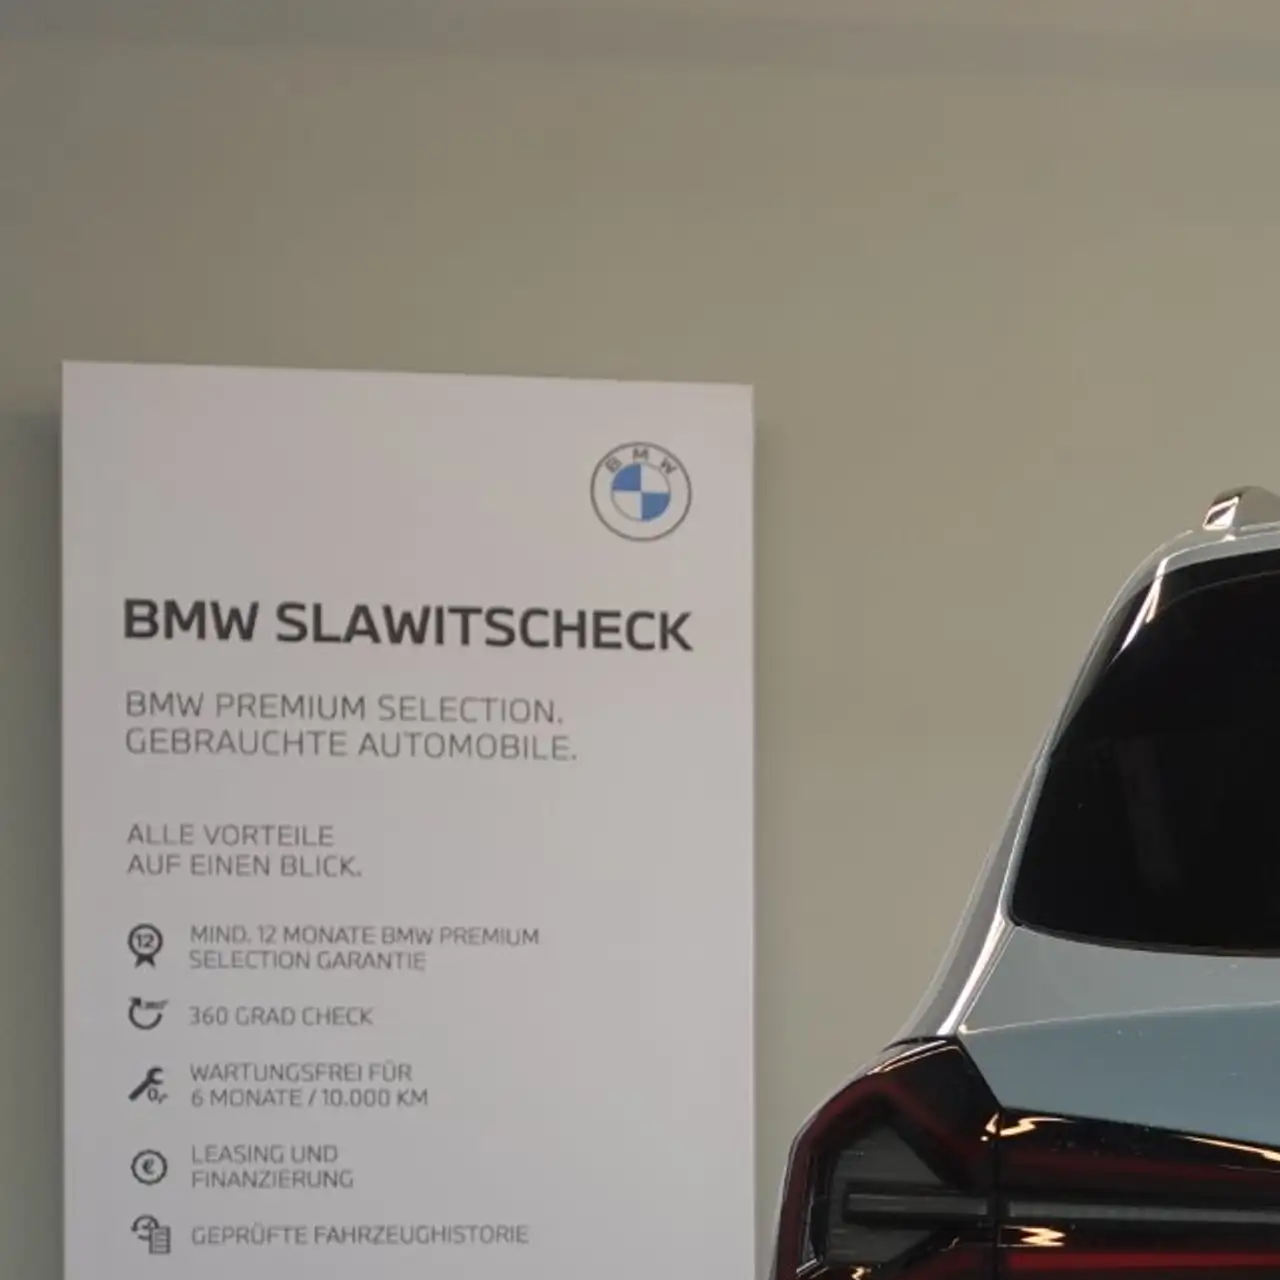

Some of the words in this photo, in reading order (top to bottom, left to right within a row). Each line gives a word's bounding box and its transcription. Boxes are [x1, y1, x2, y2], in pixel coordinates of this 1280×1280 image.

[604, 447, 678, 474] BMW
[123, 597, 260, 642] BMW
[275, 600, 693, 653] SLAWITSCHECK
[125, 690, 205, 719] BMW
[215, 691, 366, 722] PREMIUM
[377, 694, 564, 725] SELECTION.
[125, 726, 349, 758] GEBRAUCHTE
[357, 731, 578, 762] AUTOMOBILE.
[126, 822, 194, 847] ALLE
[202, 823, 335, 849] VORTEILE
[126, 853, 181, 877] AUF
[189, 854, 271, 878] EINEN
[280, 854, 362, 879] BLICK.
[189, 924, 253, 946] MIND.
[257, 924, 278, 946] 12
[282, 924, 376, 947] MONATE
[380, 925, 435, 947] BMW
[439, 925, 540, 948] PREMIUM
[188, 949, 311, 971] SELECTION
[316, 949, 427, 972] GARANTIE
[188, 1005, 229, 1027] 360
[234, 1005, 297, 1027] GRAD
[301, 1005, 374, 1027] CHECK
[189, 1062, 363, 1084] WARTUNGSFREI
[368, 1059, 413, 1083] FÜR
[190, 1088, 205, 1109] 6
[209, 1087, 303, 1109] MONATE
[320, 1087, 391, 1108] 10.000
[396, 1088, 429, 1108] KM
[191, 1143, 285, 1166] LEASING
[290, 1144, 339, 1166] UND
[191, 1168, 355, 1190] FINANZIERUNG
[190, 1221, 309, 1247] GEPRÜFTE
[313, 1224, 530, 1246] FAHRZEUGHISTORIE
